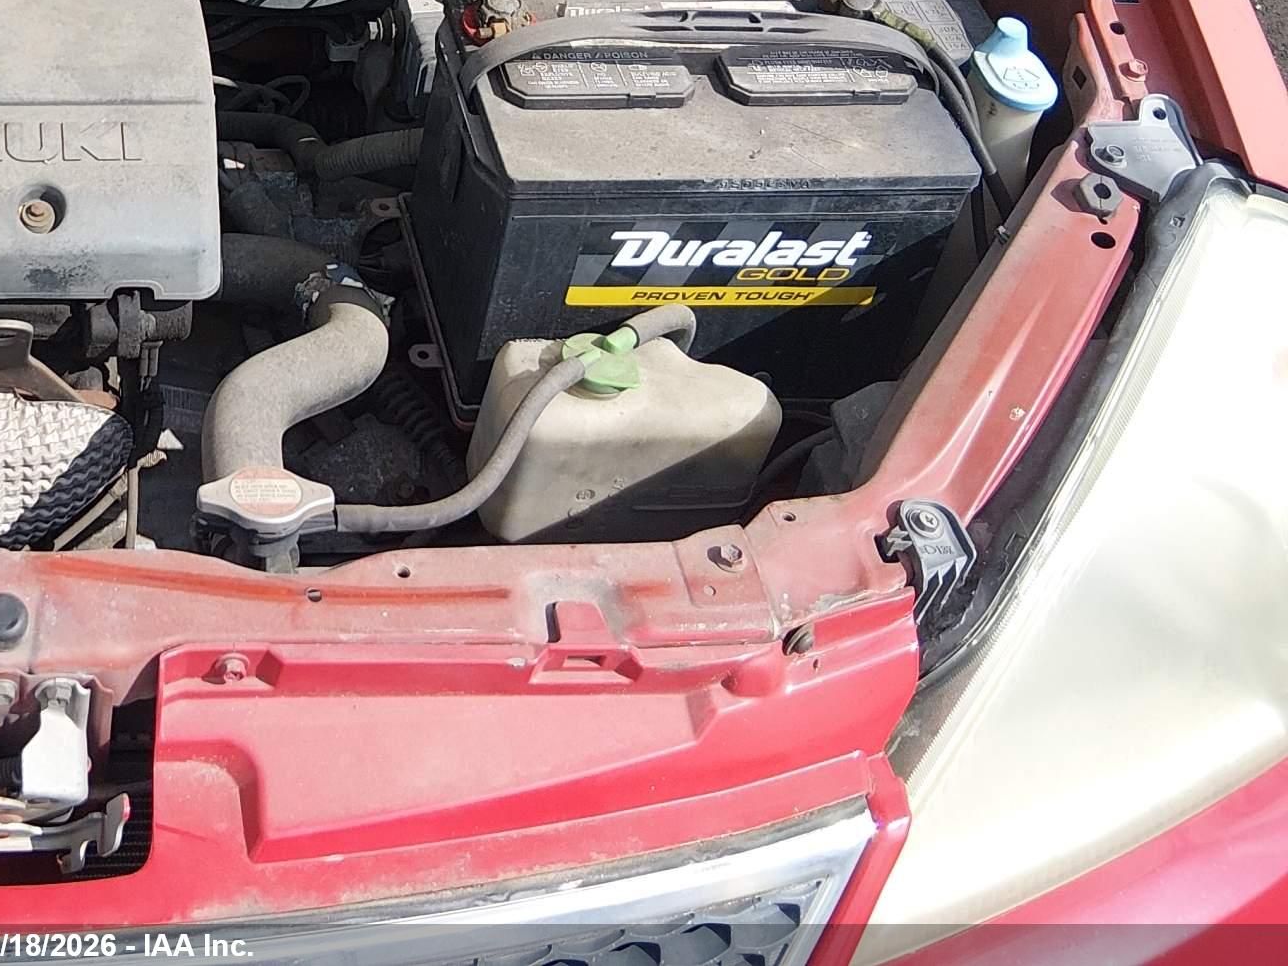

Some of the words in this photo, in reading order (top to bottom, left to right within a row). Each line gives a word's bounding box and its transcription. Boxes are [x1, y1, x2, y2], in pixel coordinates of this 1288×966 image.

[543, 52, 592, 60] DANGER
[610, 230, 870, 267] Duralast
[736, 267, 850, 281] GOLD
[631, 291, 727, 301] PROVEN
